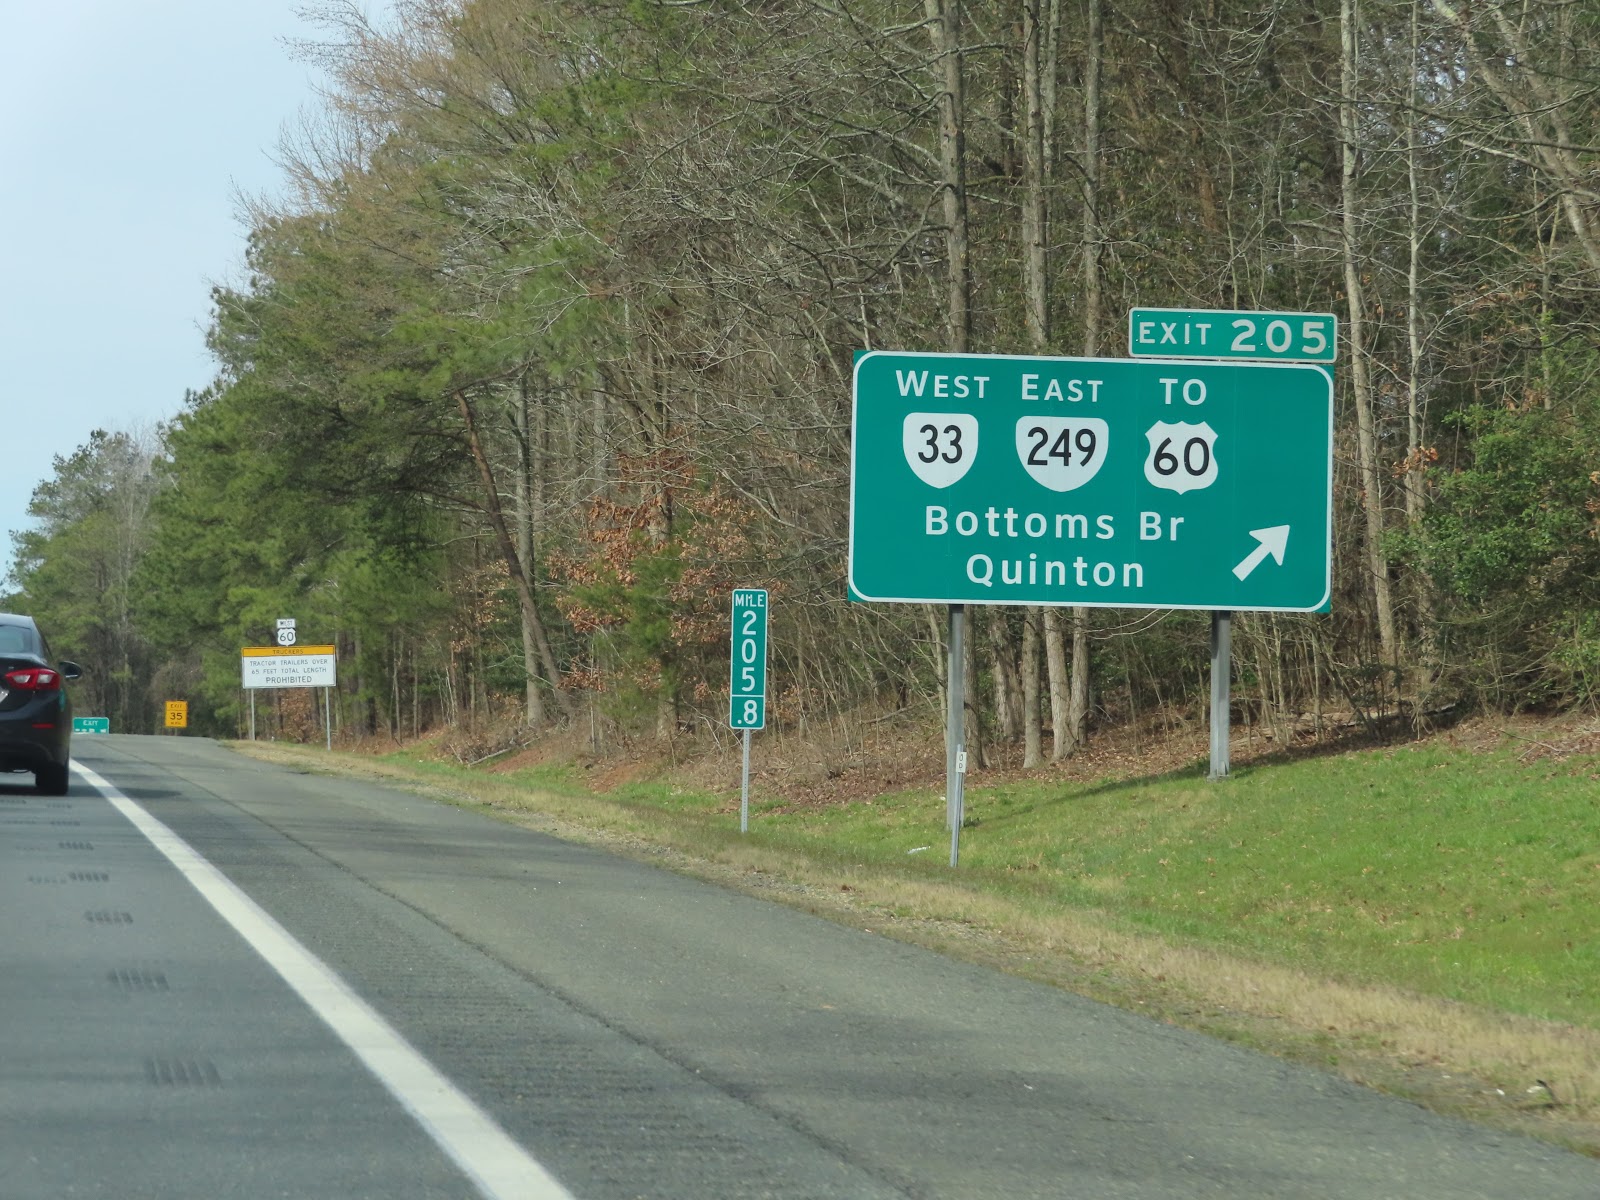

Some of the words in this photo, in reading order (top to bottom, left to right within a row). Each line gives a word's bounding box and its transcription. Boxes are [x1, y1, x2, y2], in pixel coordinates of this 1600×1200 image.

[1138, 321, 1212, 346] EXIT
[1231, 319, 1327, 354] 205
[895, 370, 990, 399] WEST
[1021, 373, 1103, 402] EAST
[1159, 378, 1207, 406] TO
[917, 424, 963, 464] 33
[1027, 426, 1096, 468] 249
[1153, 436, 1210, 477] 60
[926, 505, 1115, 540] Bottoms
[1139, 511, 1184, 542] Br
[966, 553, 1145, 589] Quinton
[735, 593, 765, 608] MILE
[279, 631, 294, 642] 60
[266, 676, 312, 684] PROHIBITED
[170, 712, 183, 720] 35
